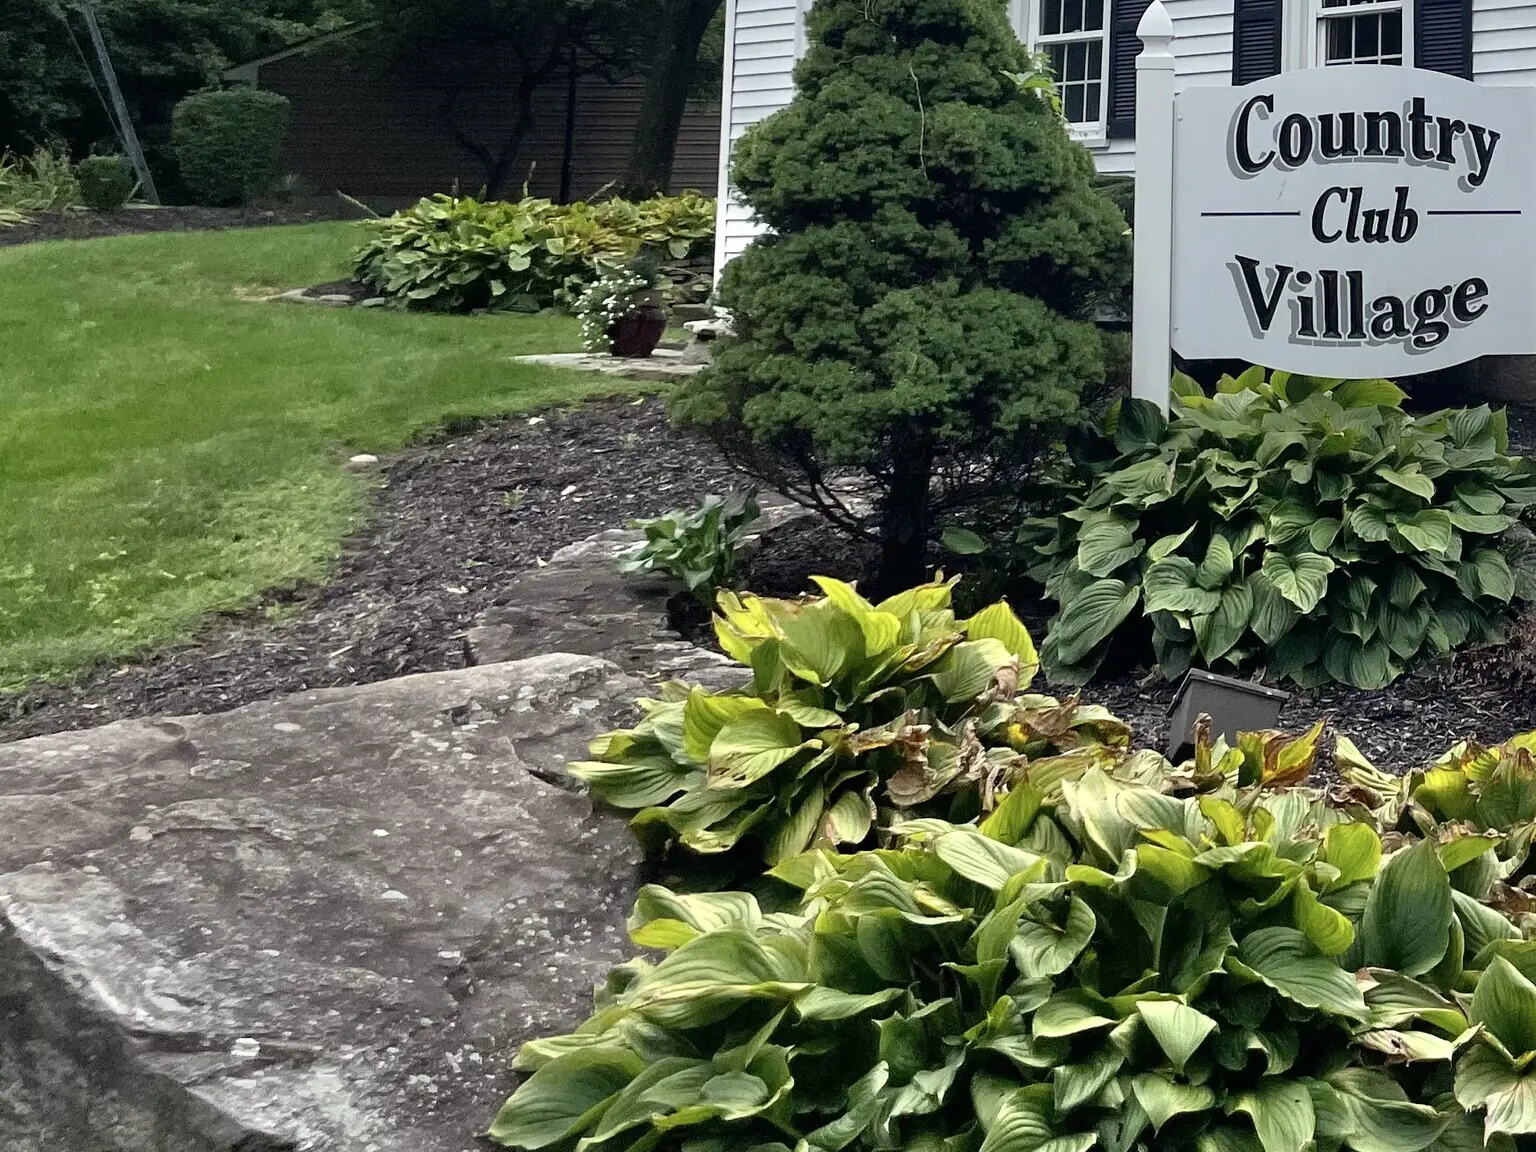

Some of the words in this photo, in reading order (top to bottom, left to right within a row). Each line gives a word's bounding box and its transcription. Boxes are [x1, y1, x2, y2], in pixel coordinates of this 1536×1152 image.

[1228, 93, 1501, 191] Country
[1311, 186, 1419, 243] Club
[1227, 255, 1490, 352] Village
